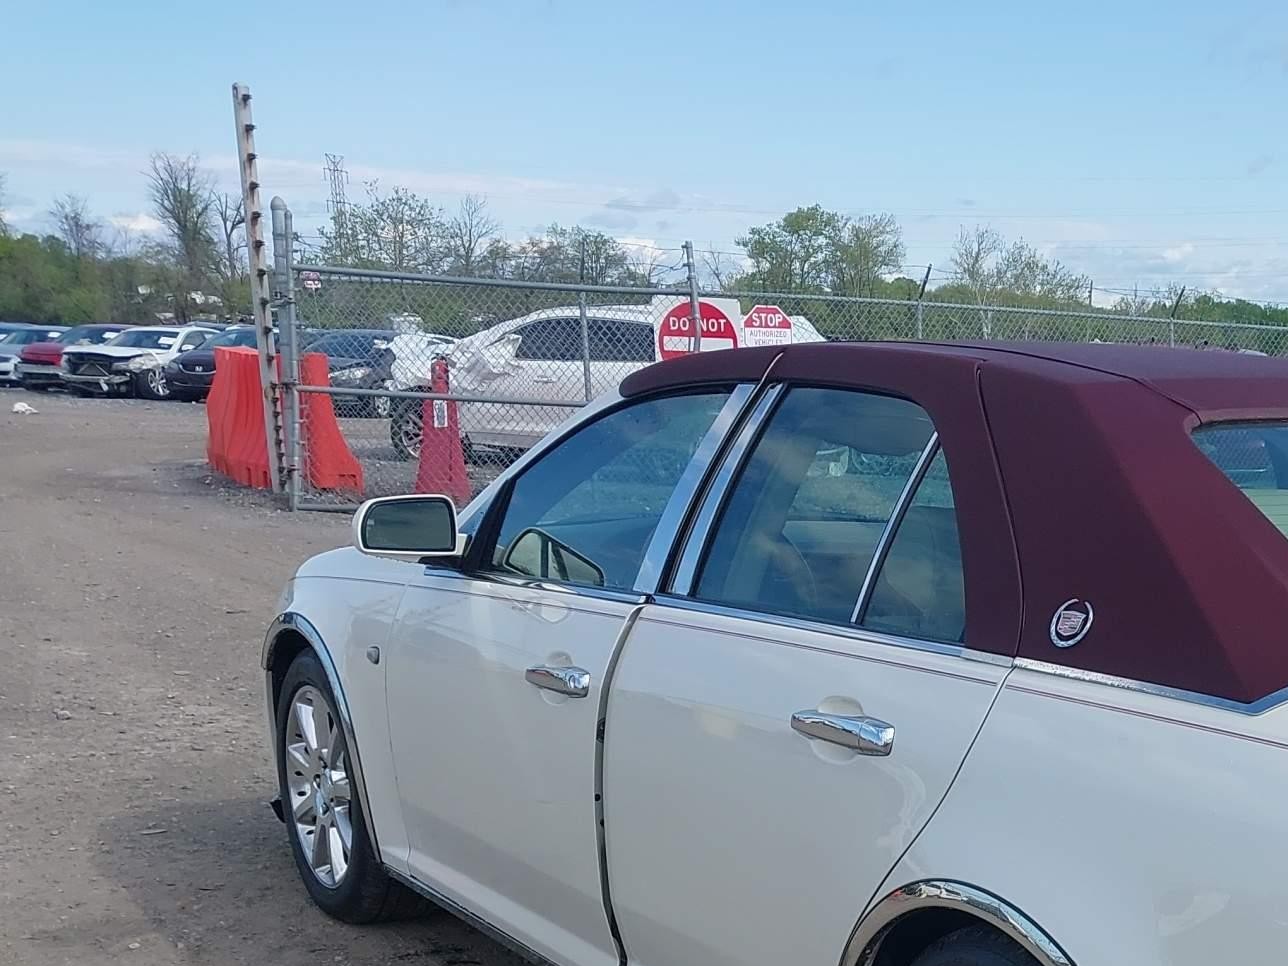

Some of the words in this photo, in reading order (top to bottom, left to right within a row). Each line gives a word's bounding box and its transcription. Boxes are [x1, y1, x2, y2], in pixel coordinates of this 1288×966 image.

[669, 317, 689, 331] DO
[699, 318, 727, 332] NOT
[751, 313, 783, 327] STOP
[749, 329, 787, 338] AUTHORIZED
